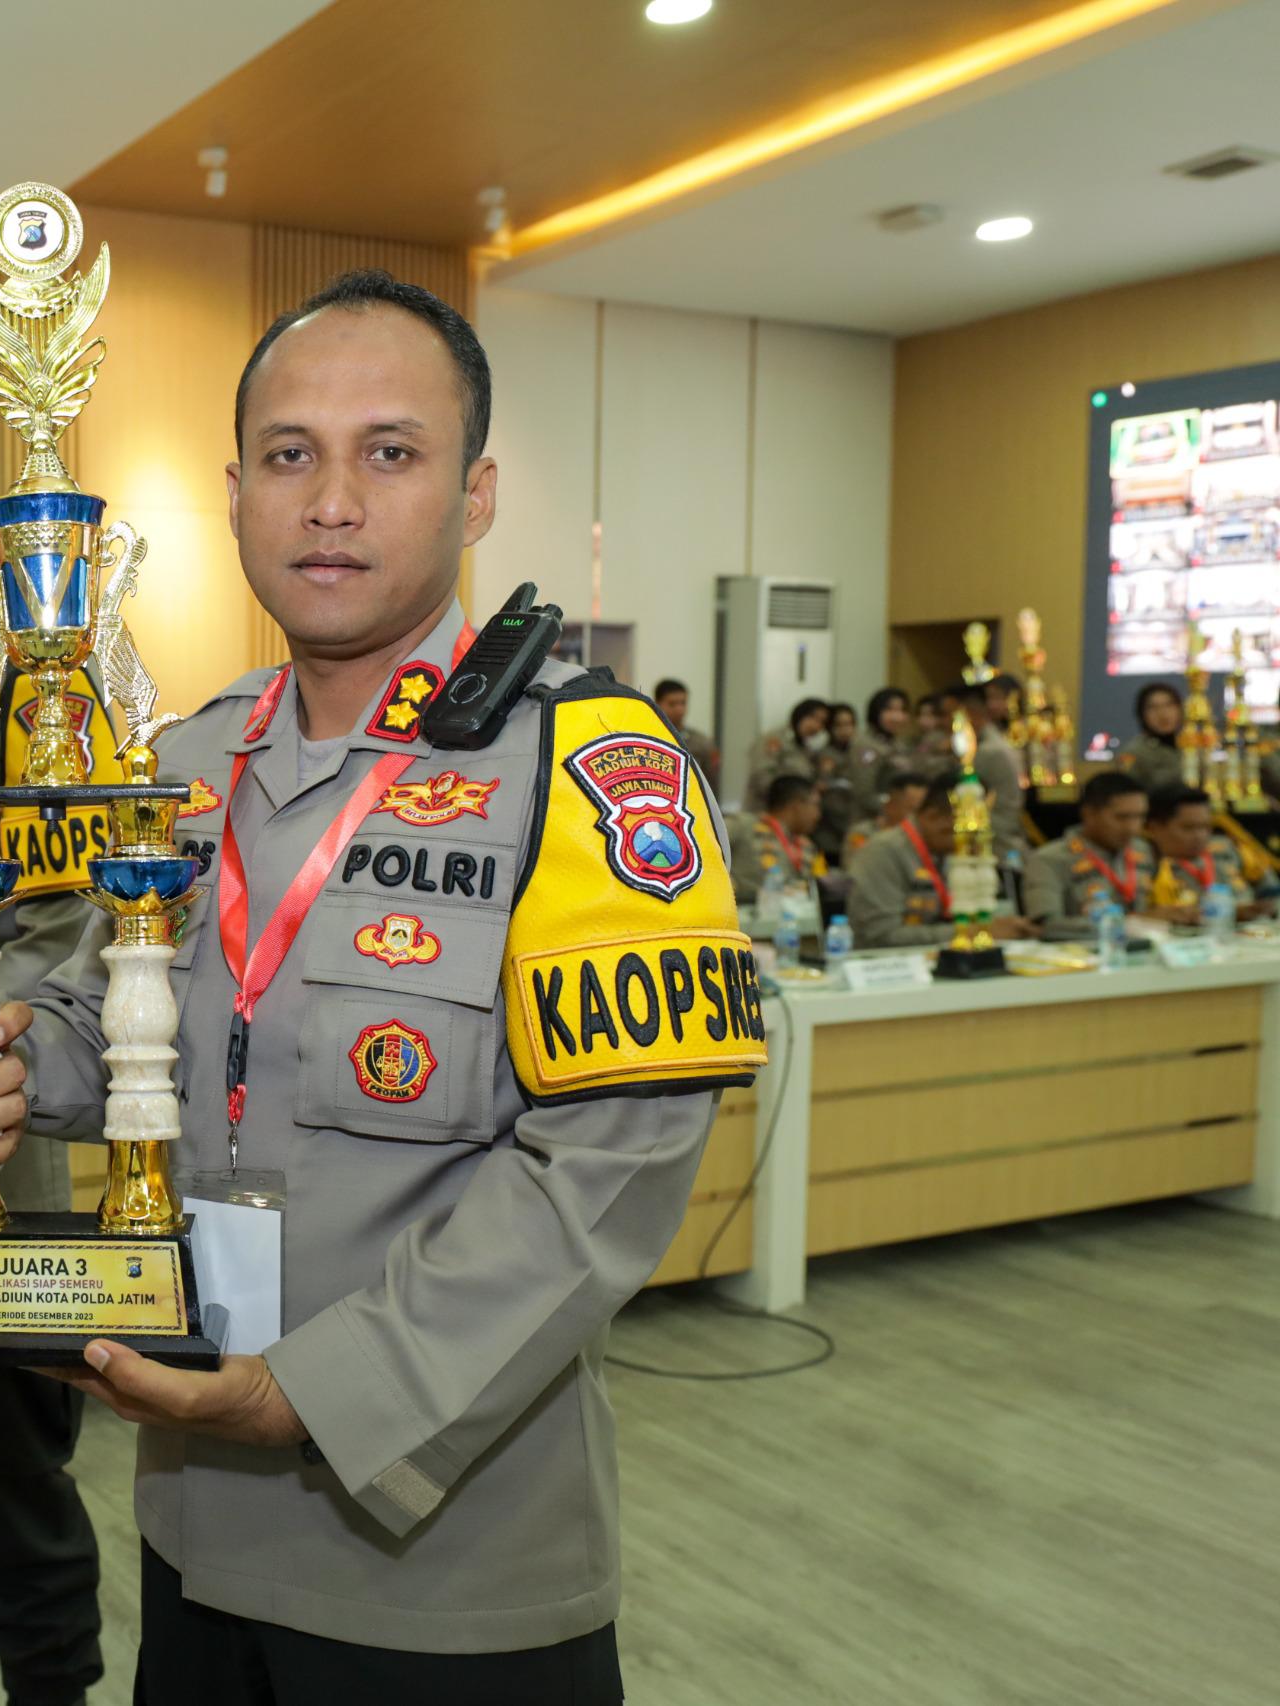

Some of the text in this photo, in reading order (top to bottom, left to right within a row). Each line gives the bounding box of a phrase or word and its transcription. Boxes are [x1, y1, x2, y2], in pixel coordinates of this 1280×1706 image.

[587, 747, 676, 772] POLRES
[644, 757, 675, 776] KOTA
[609, 780, 675, 798] JAWA TIMUR
[6, 814, 112, 877] KAOPS
[341, 843, 496, 900] POLRI
[369, 1084, 410, 1097] PROPAM
[75, 1258, 87, 1276] 3
[33, 1279, 56, 1288] SIAP
[60, 1279, 103, 1289] SEMERU
[36, 1292, 69, 1304] KOTA
[72, 1293, 114, 1305] POLDA
[117, 1293, 155, 1305] JATIM
[28, 1311, 72, 1320] DESEMBER
[74, 1312, 94, 1321] 2023
